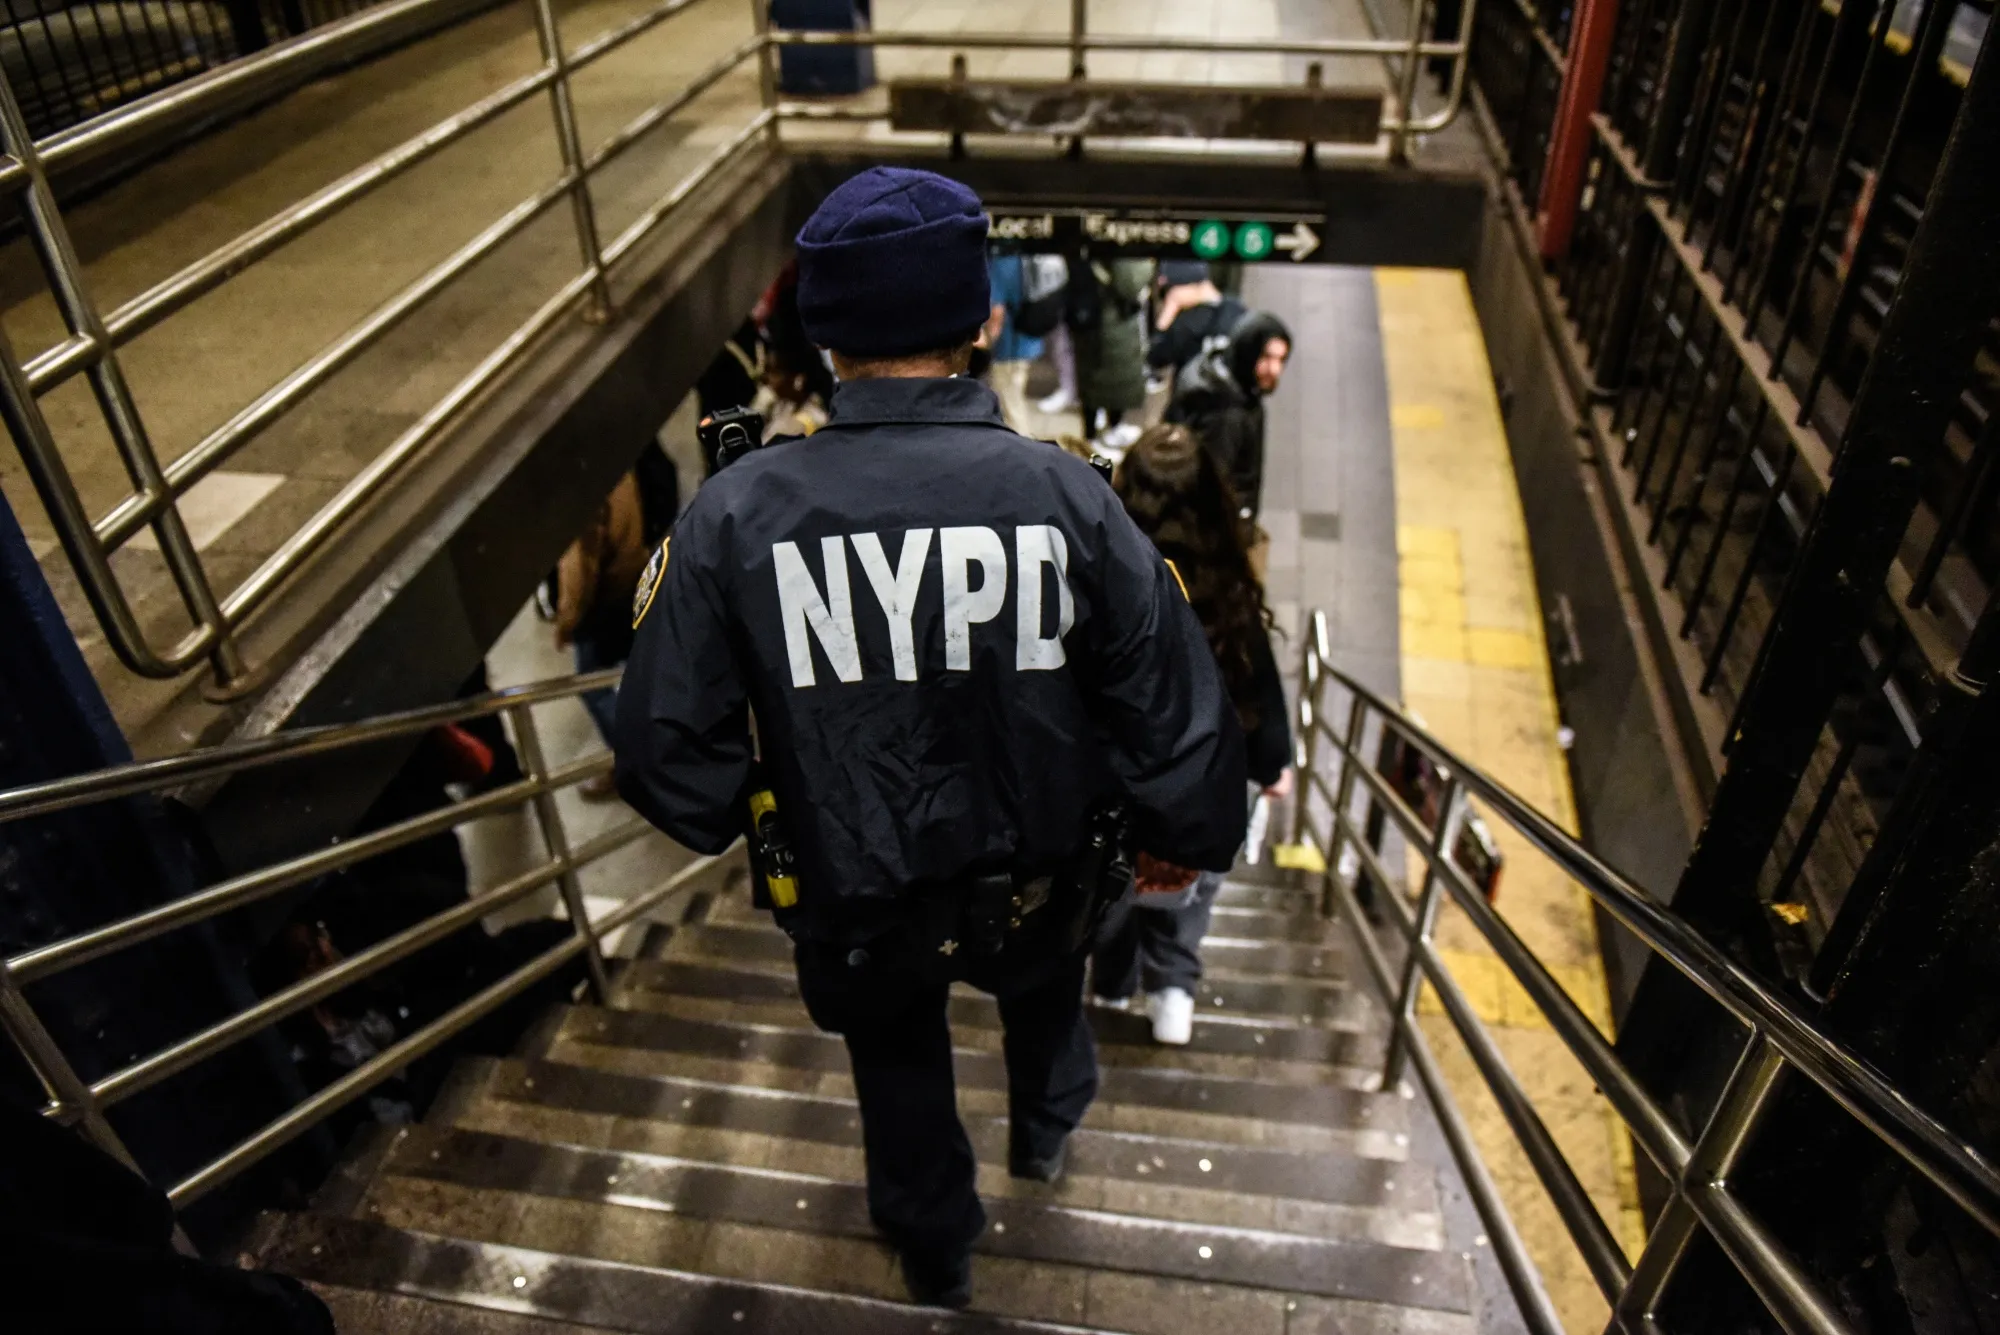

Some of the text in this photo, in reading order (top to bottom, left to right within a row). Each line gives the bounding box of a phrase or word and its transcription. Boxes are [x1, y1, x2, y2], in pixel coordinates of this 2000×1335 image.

[987, 213, 1054, 239] Local
[1085, 213, 1190, 245] Express
[1200, 225, 1219, 250] 4
[773, 524, 1074, 687] NYPD
